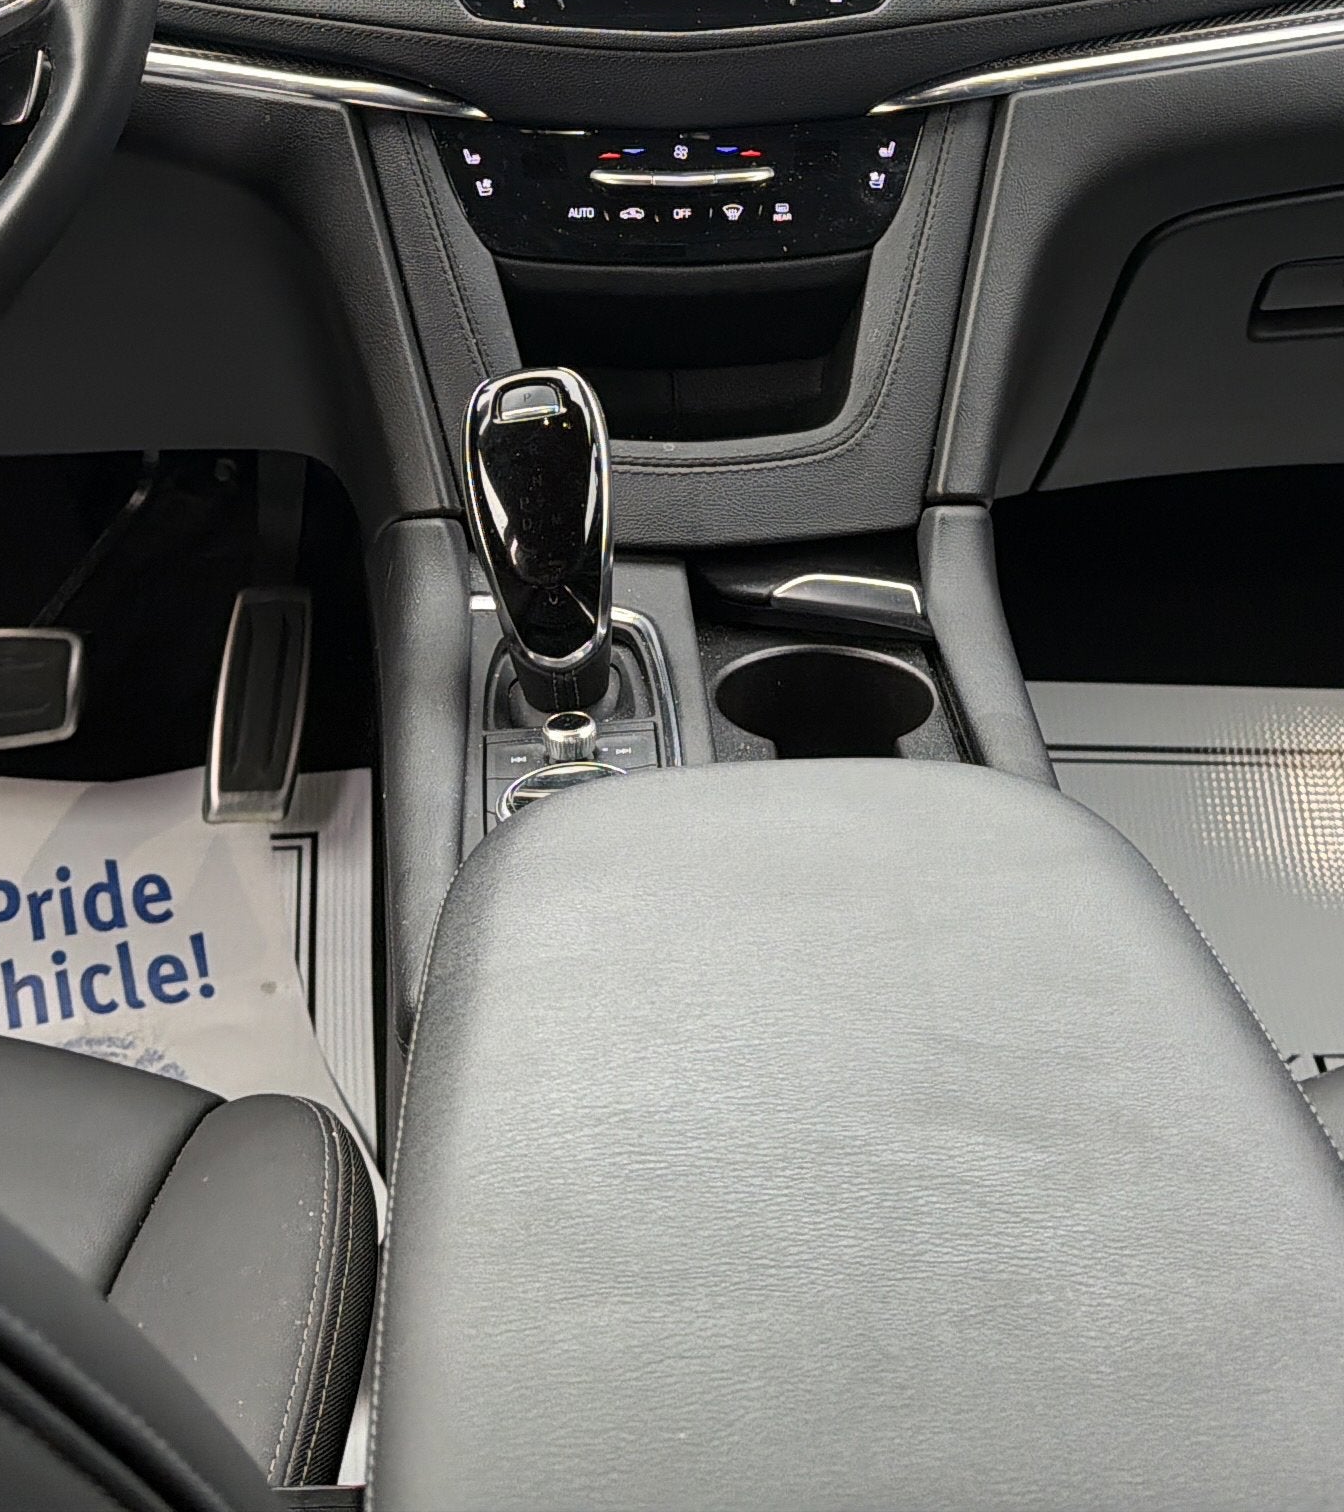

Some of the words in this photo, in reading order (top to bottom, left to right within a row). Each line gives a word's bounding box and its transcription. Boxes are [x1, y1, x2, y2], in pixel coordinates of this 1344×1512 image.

[568, 207, 595, 219] AUTO
[673, 208, 692, 219] OFF
[772, 212, 793, 221] REAR
